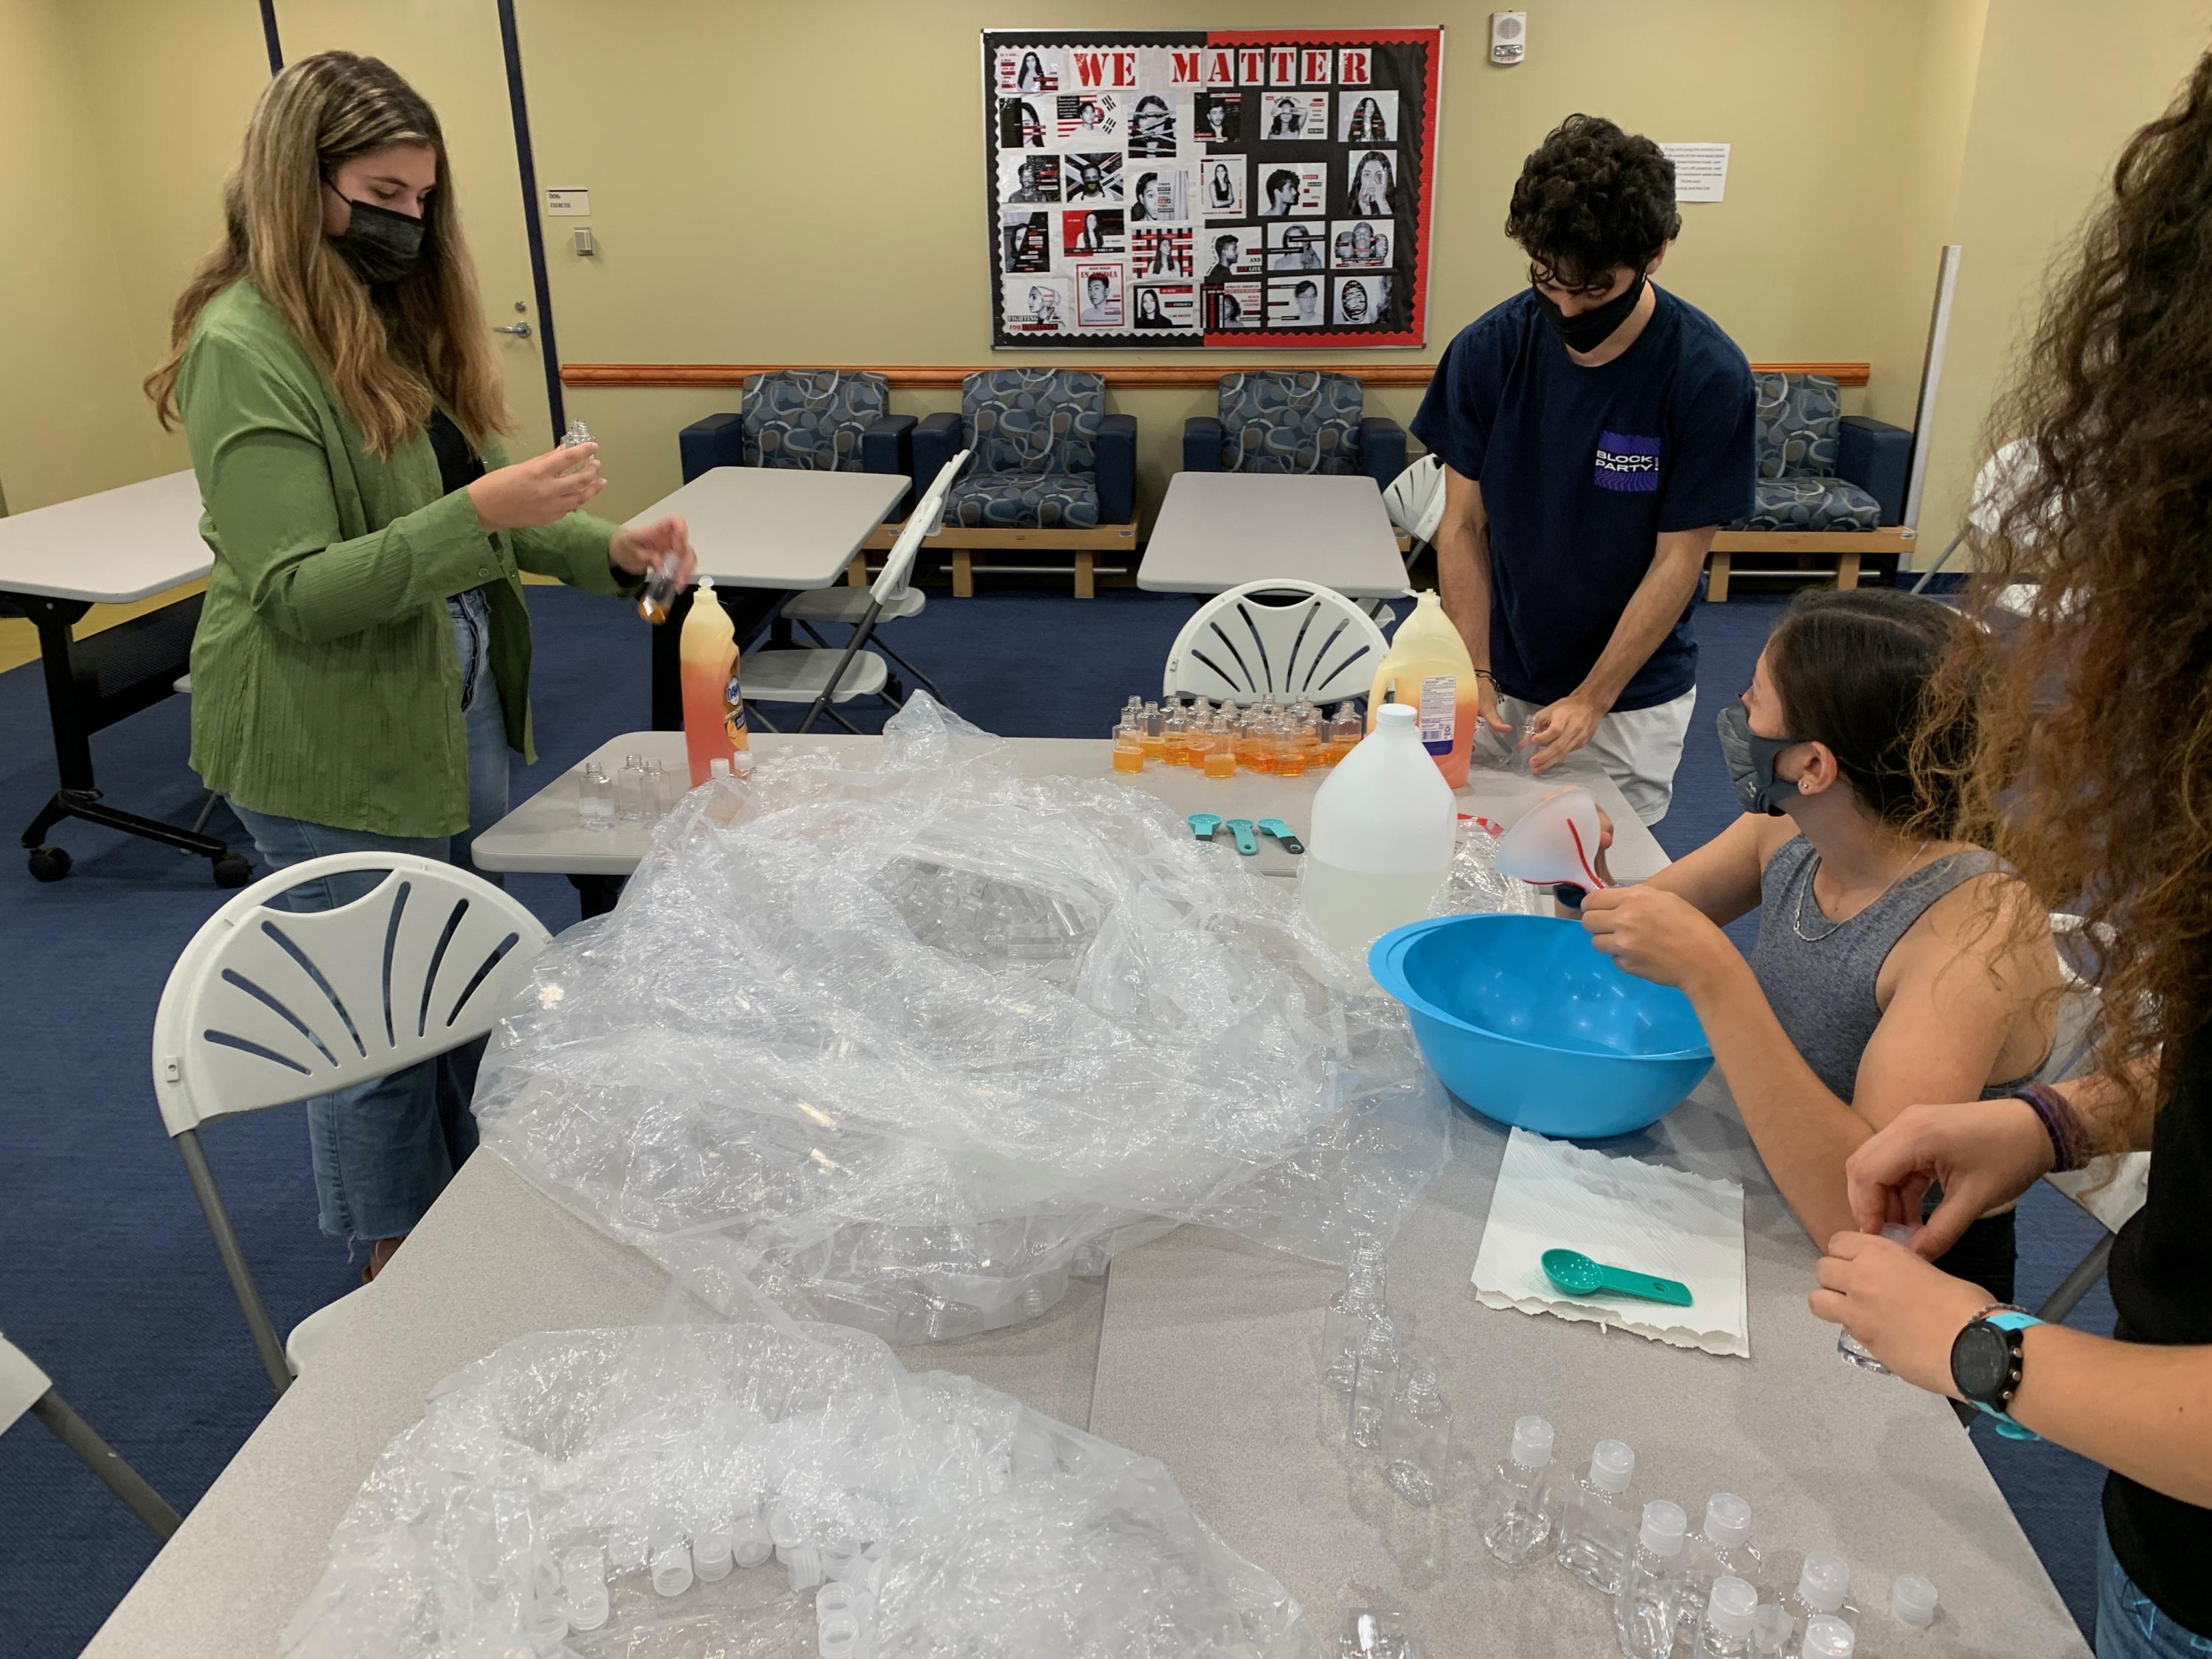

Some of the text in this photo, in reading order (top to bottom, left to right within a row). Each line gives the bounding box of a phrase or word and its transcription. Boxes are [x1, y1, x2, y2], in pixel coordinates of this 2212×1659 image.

[1074, 52, 1135, 86] WE
[1172, 52, 1368, 83] MATTER
[1596, 450, 1653, 463] BLOCK
